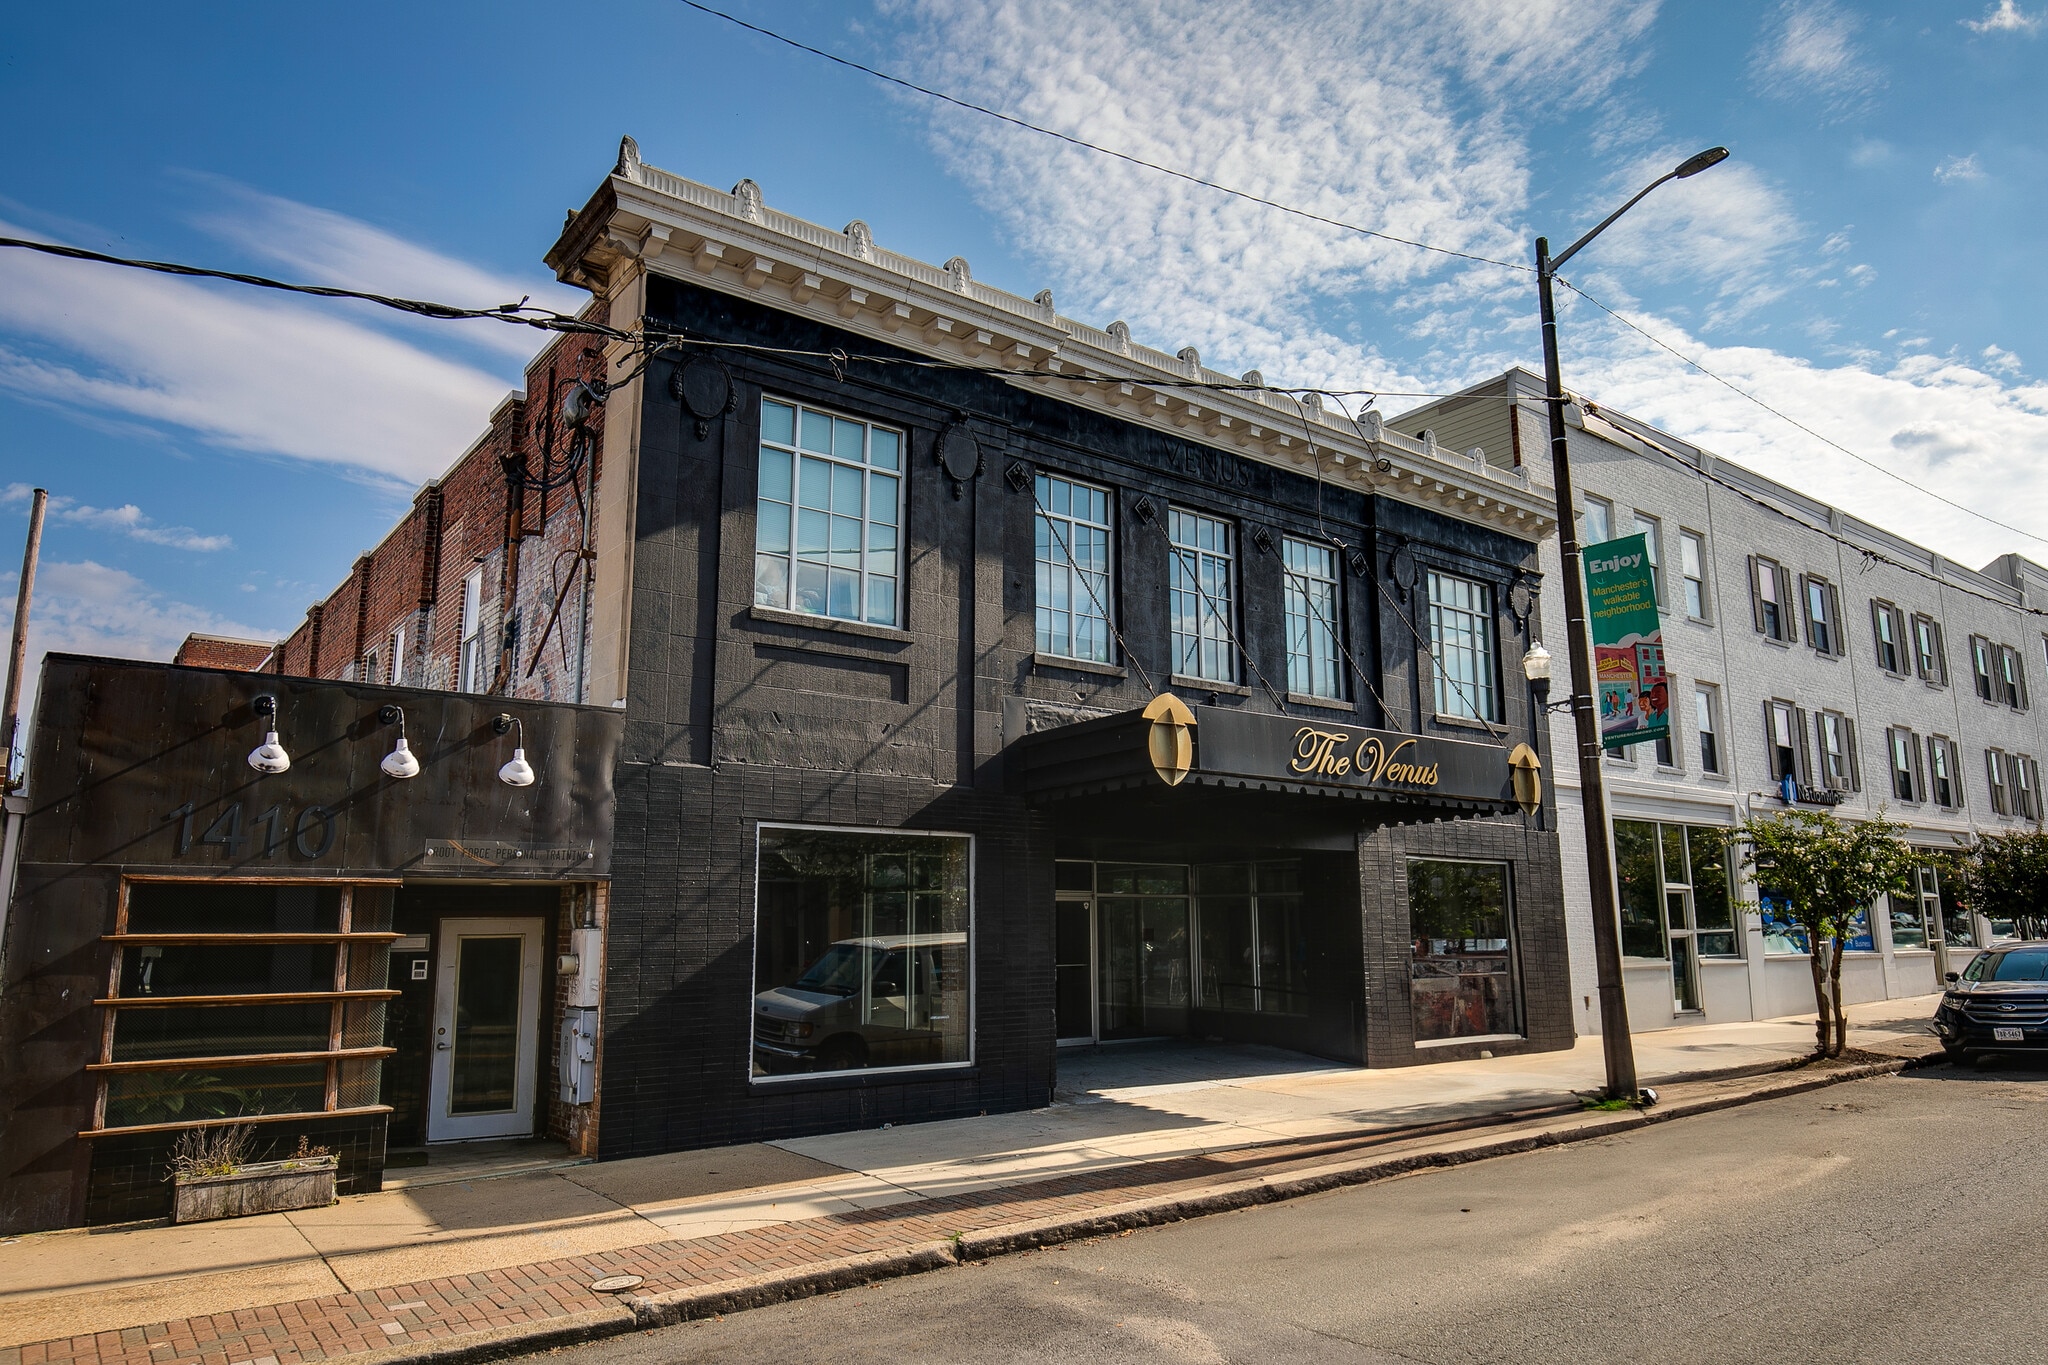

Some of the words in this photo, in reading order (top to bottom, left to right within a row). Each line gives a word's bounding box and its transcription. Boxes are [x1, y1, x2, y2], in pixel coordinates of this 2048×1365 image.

[1163, 439, 1248, 487] VENUS
[1589, 553, 1642, 574] Enjoy
[1592, 579, 1648, 597] Manchester's
[1603, 592, 1640, 606] walkable
[1291, 727, 1349, 776] The
[1356, 737, 1438, 785] Venus
[168, 801, 335, 858] 1410
[496, 848, 538, 860] PERSONAL
[546, 849, 587, 861] TRAINING
